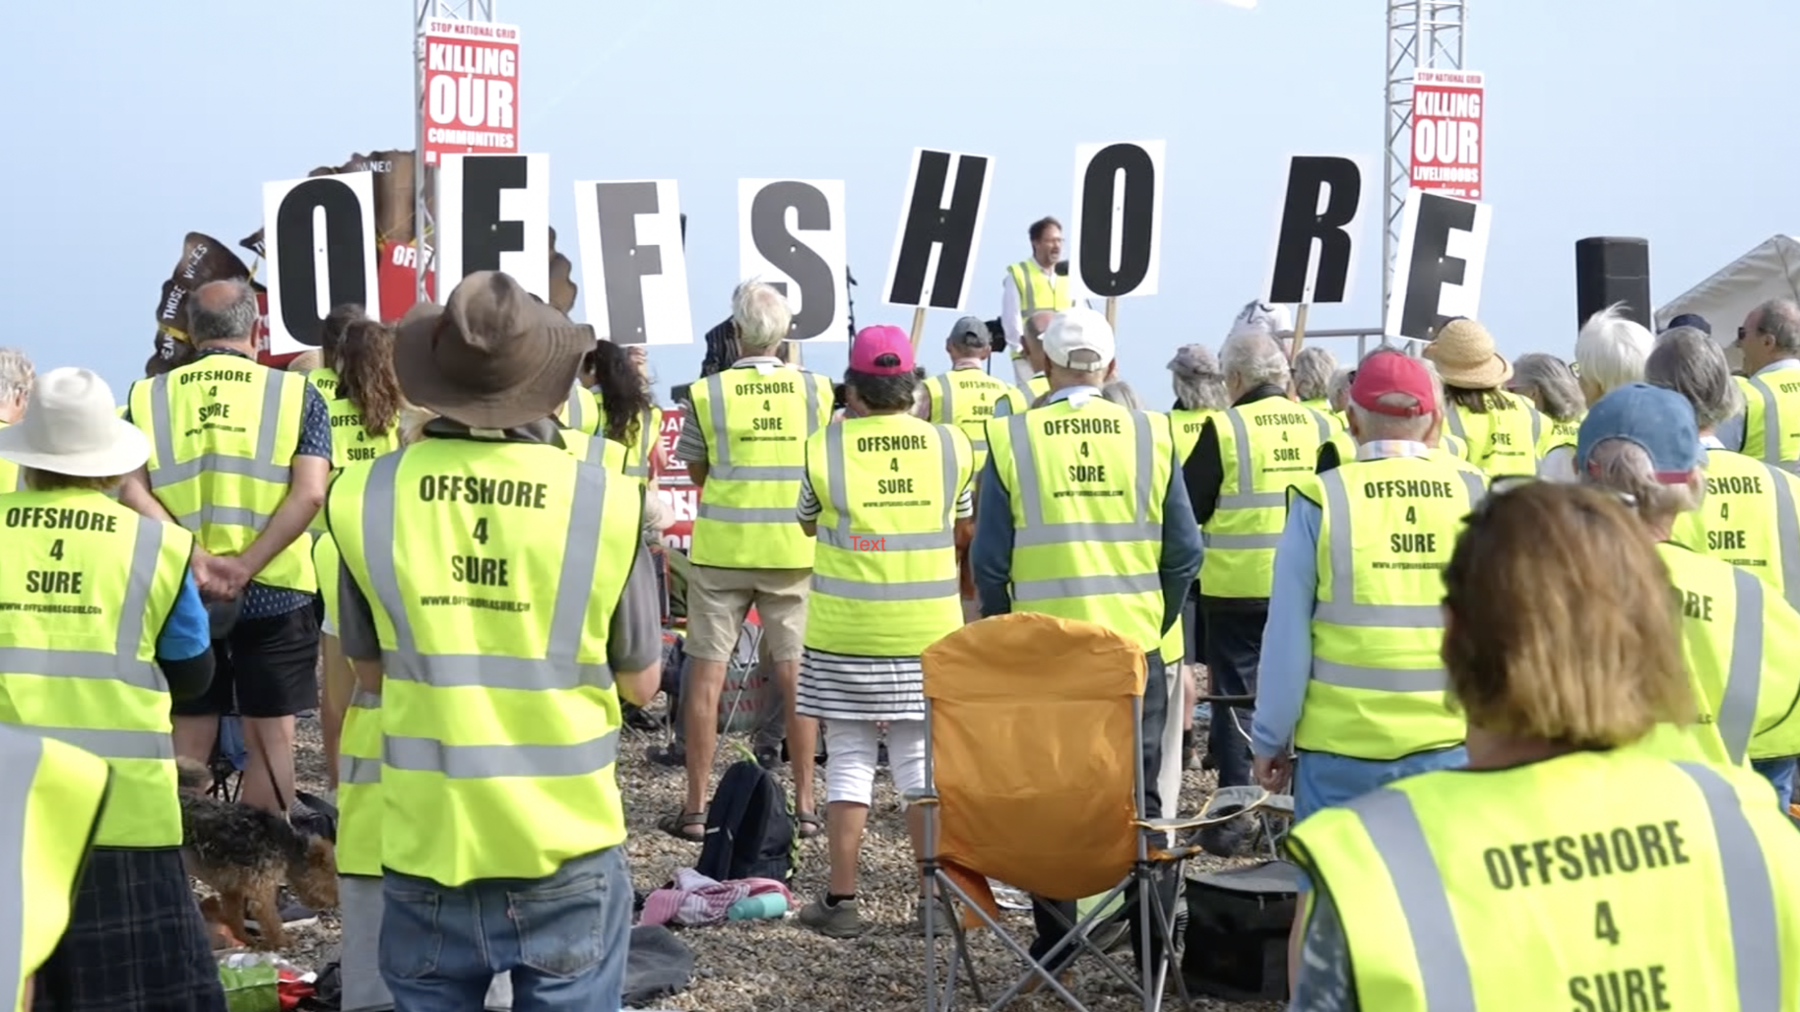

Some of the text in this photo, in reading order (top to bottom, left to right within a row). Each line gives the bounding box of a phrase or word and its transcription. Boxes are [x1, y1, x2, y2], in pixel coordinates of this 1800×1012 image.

[430, 22, 516, 39] STOP NATIONAL GRID
[429, 43, 515, 77] KILLING
[1418, 73, 1481, 84] STOP NATIONAL GRID
[429, 74, 514, 128] OUR
[1415, 91, 1480, 118] KILLING
[427, 128, 514, 148] COMMUNITIES
[1414, 118, 1479, 164] OUR
[1413, 166, 1479, 182] LIVELIHOODS
[462, 156, 527, 278] F
[1080, 143, 1155, 297] O
[890, 150, 988, 309] H
[1269, 156, 1361, 303] R
[277, 178, 367, 347] O
[596, 182, 662, 345] F
[751, 180, 836, 340] S
[1400, 192, 1477, 342] E
[162, 284, 187, 320] THOSE
[180, 370, 253, 385] OFFSHORE
[208, 385, 218, 397] 4
[735, 382, 795, 396] OFFSHORE
[198, 403, 231, 422] SURE
[762, 399, 771, 412] 4
[752, 417, 783, 431] SURE
[1043, 418, 1121, 436] OFFSHORE
[1254, 413, 1308, 426] OFFSHORE
[356, 431, 364, 442] 4
[857, 435, 928, 452] OFFSHORE
[1281, 431, 1288, 442] 4
[1491, 433, 1512, 445] SRE
[347, 447, 376, 461] SURE
[1080, 441, 1090, 458] 4
[1273, 448, 1301, 461] SURE
[890, 457, 899, 473] 4
[1068, 465, 1106, 482] SURE
[419, 475, 547, 509] OFFSHORE
[877, 478, 914, 494] SURE
[1364, 479, 1453, 498] OFFSHORE
[1706, 476, 1763, 495] SHORE
[6, 507, 117, 533] OFFSHORE
[1405, 506, 1417, 525] 4
[1720, 502, 1729, 521] 4
[472, 517, 488, 545] 4
[50, 538, 64, 561] 4
[1390, 533, 1436, 553] SURE
[451, 555, 508, 587] SURE
[26, 570, 82, 594] SURE
[1483, 820, 1690, 890] OFFSHORE
[1595, 901, 1620, 945] 4
[1568, 965, 1671, 1012] SURE
